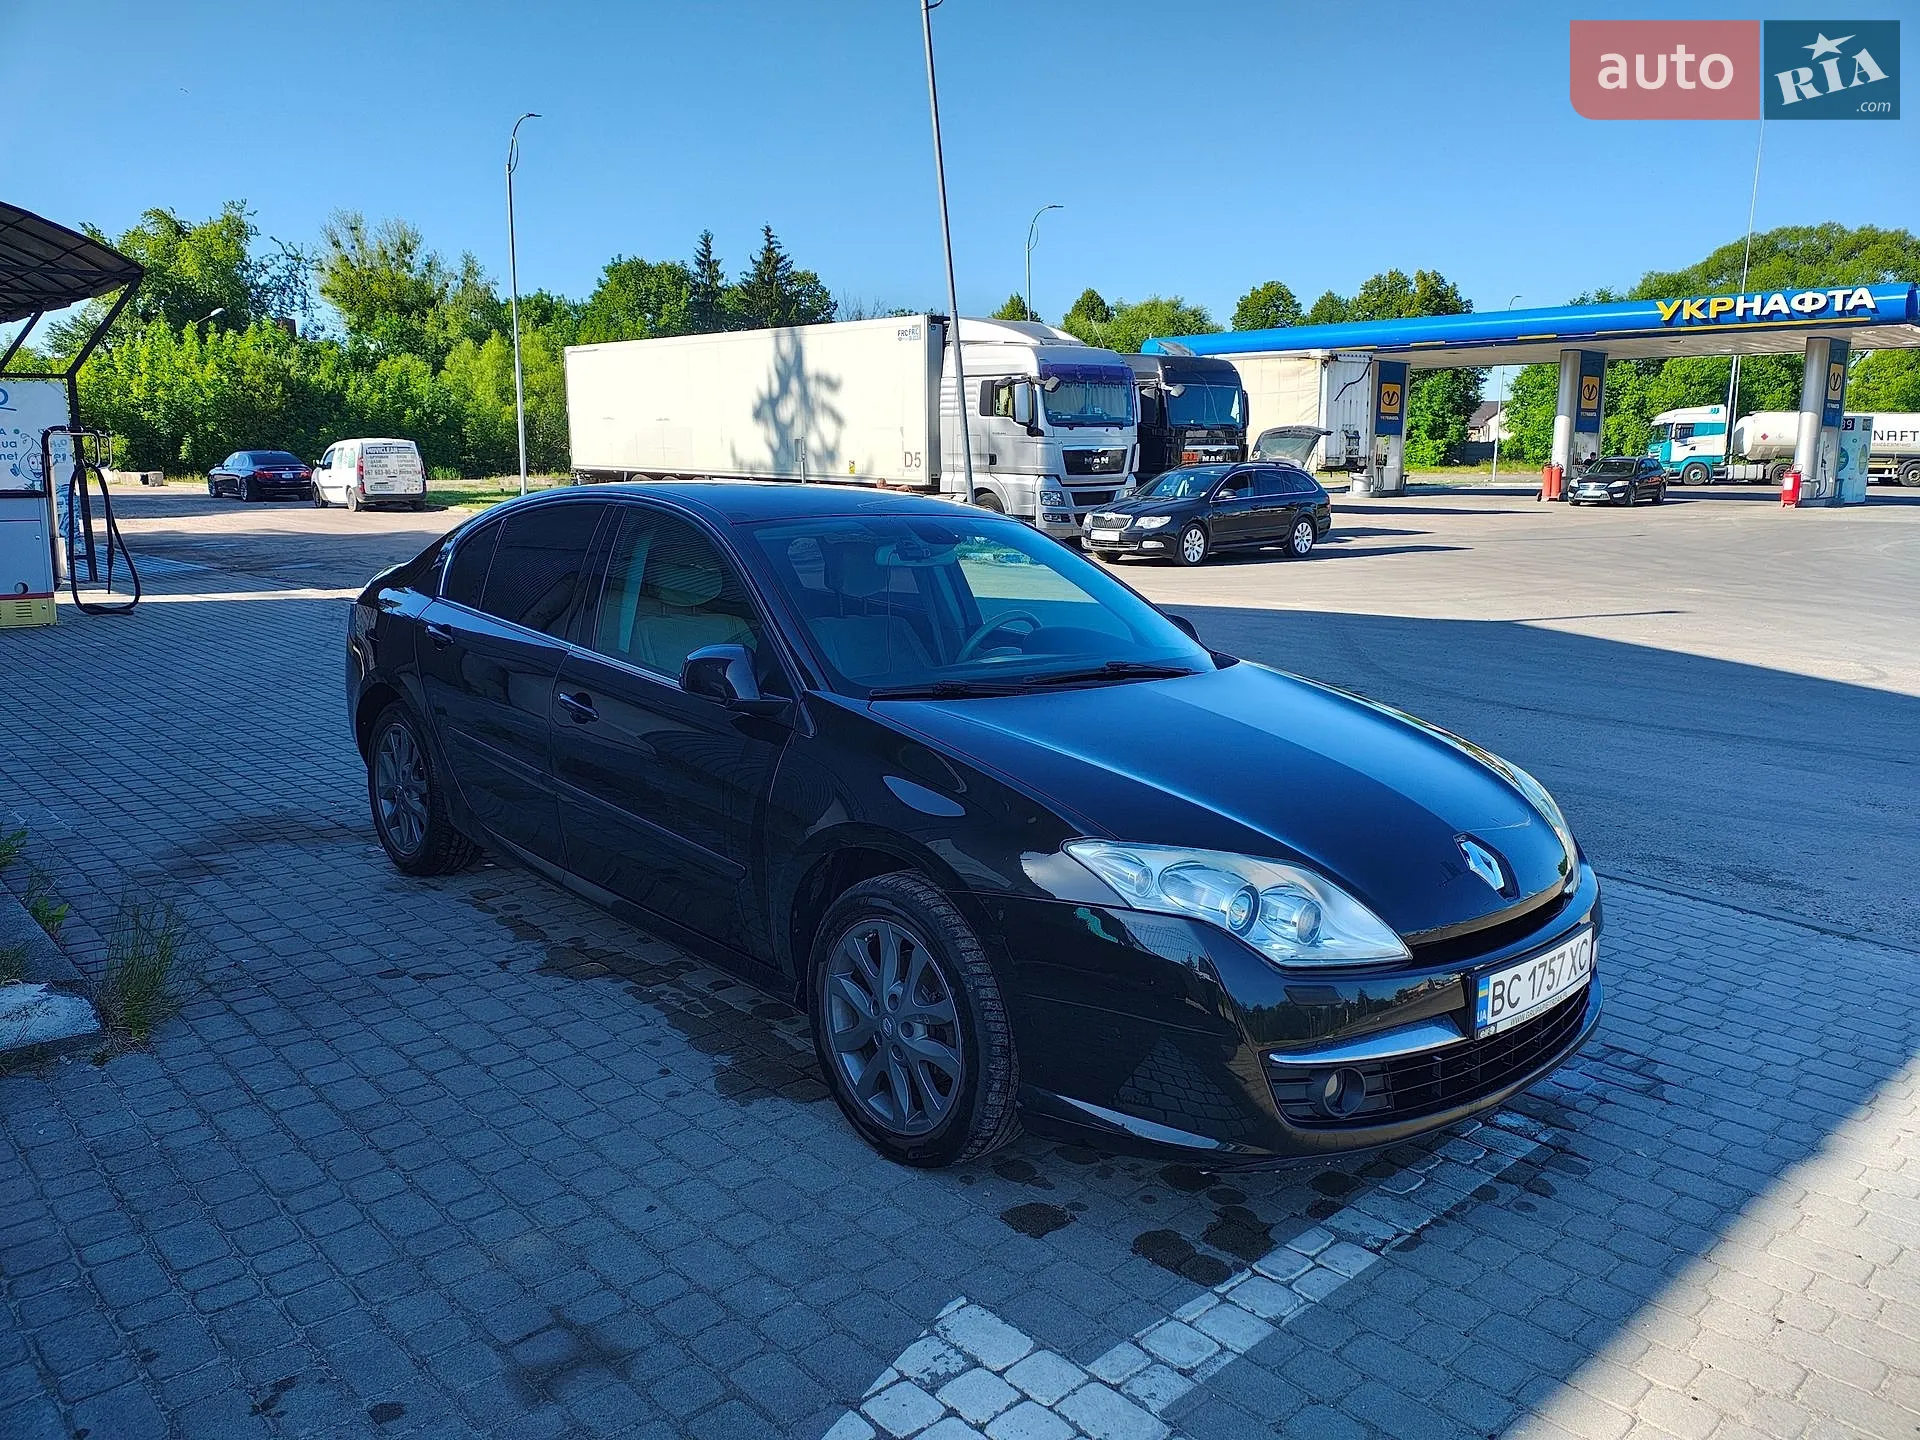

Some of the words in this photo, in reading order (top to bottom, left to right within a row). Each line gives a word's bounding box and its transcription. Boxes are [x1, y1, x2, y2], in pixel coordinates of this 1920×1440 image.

[1656, 288, 1876, 321] УКРНАФТА
[1873, 430, 1920, 442] NAFT
[904, 451, 922, 469] D5
[1491, 973, 1522, 1018] BC
[1528, 951, 1566, 1001] 1757
[1567, 938, 1588, 982] XC
[1477, 1009, 1487, 1023] UA
